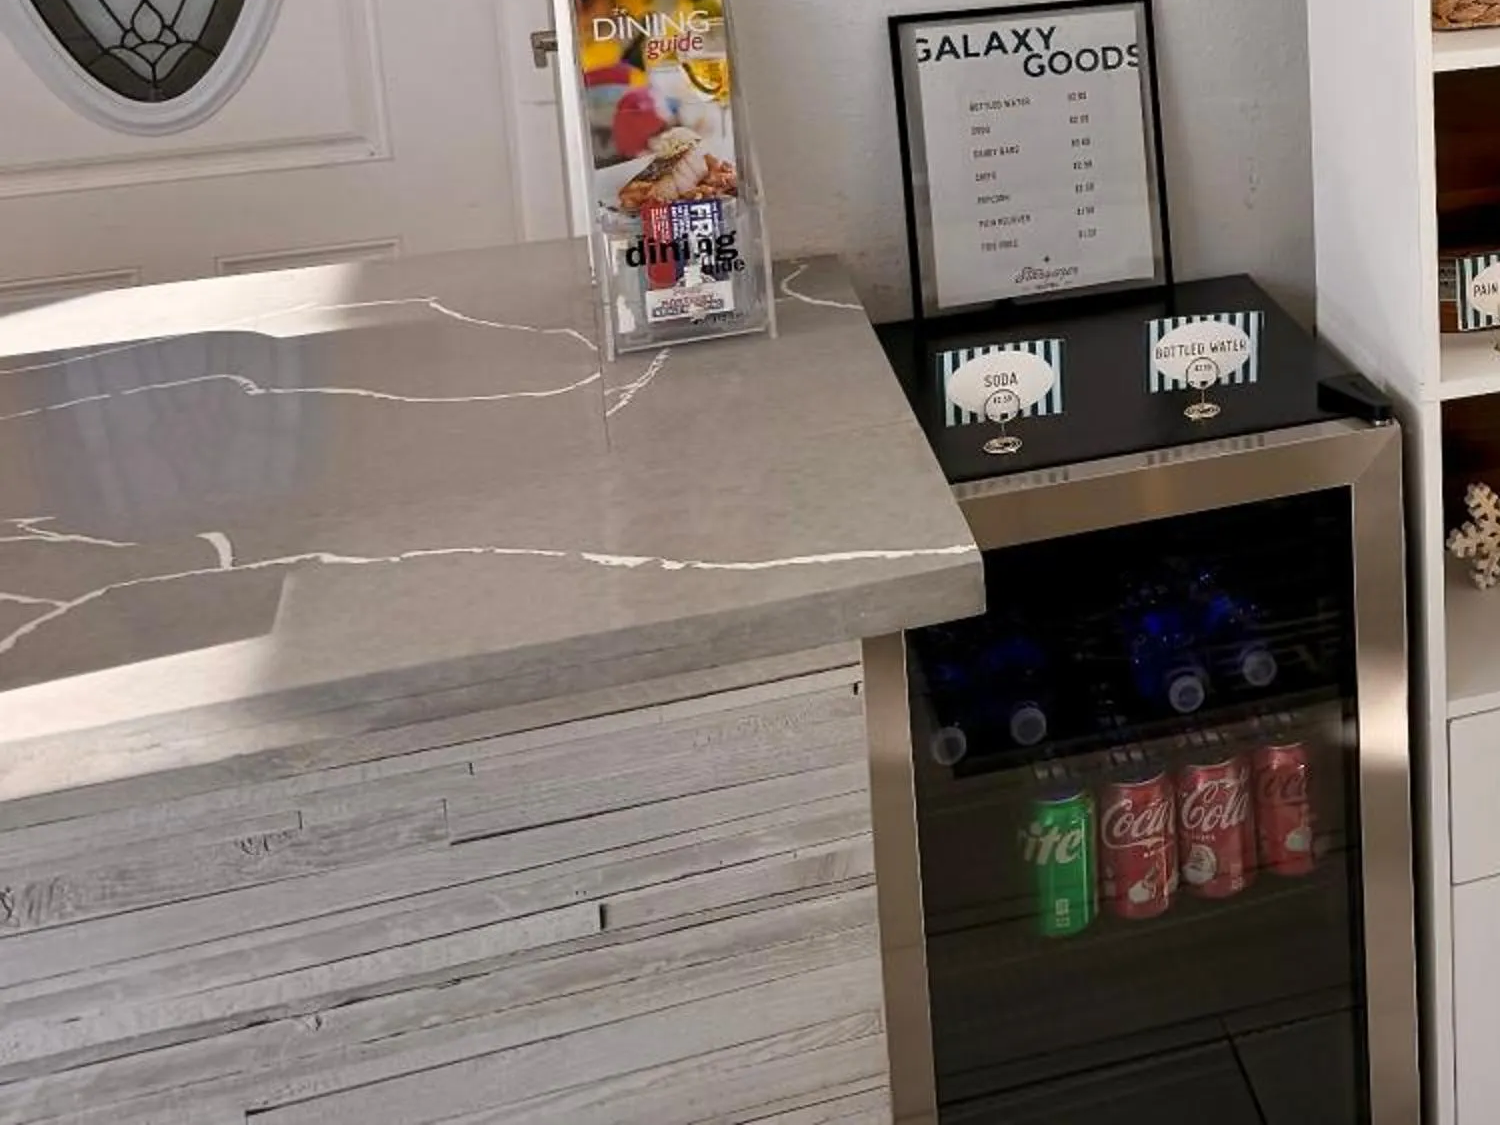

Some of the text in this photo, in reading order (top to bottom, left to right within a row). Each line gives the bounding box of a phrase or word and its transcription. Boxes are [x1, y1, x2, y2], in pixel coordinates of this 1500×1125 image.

[593, 9, 711, 42] DINING
[646, 30, 704, 60] guide
[915, 25, 1057, 64] GALAXY
[1022, 42, 1139, 78] GOODS
[1473, 282, 1499, 298] PAIN
[1155, 338, 1247, 360] BOTTLED WATER
[983, 370, 1019, 388] SODA
